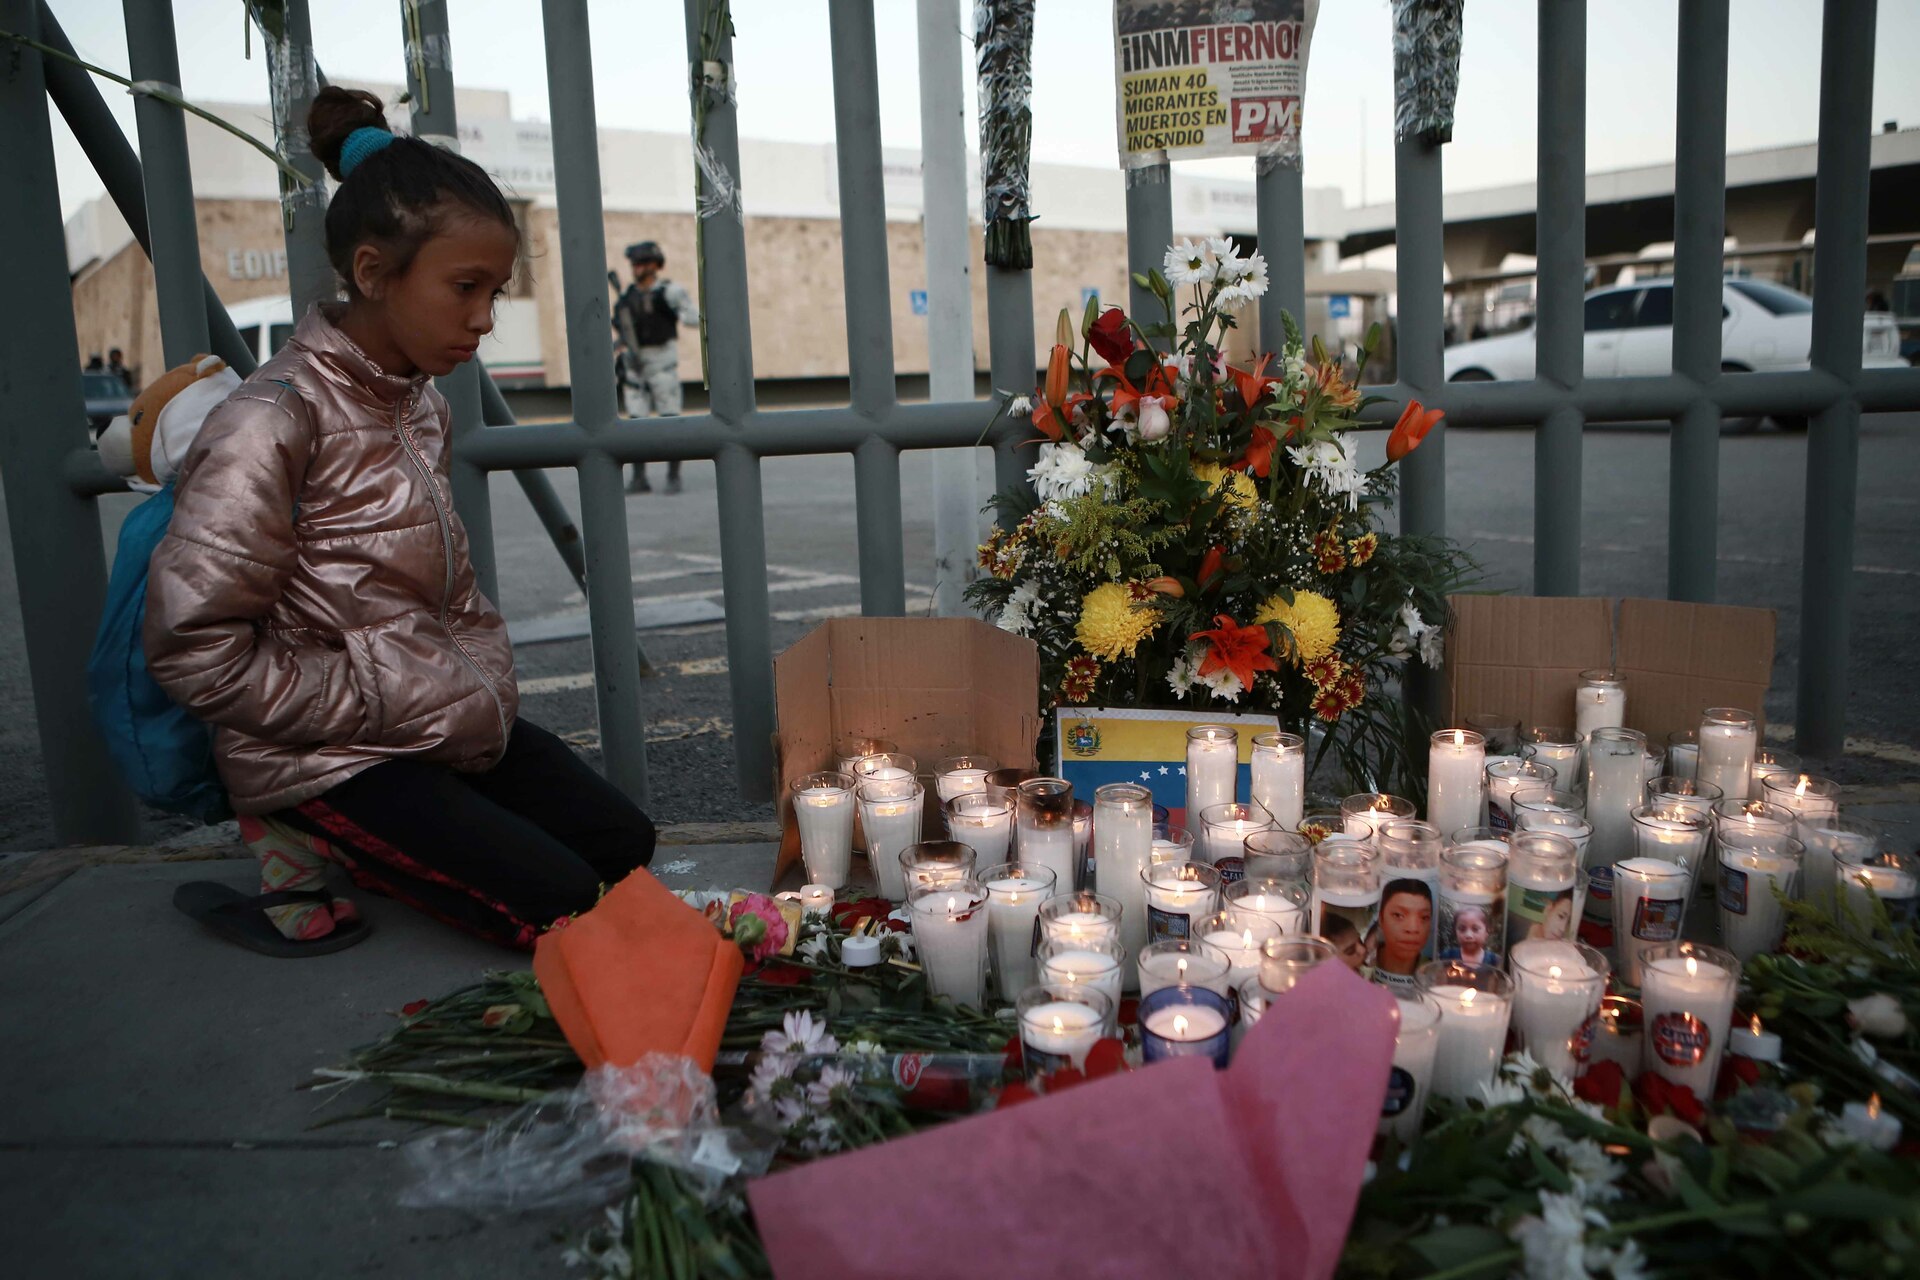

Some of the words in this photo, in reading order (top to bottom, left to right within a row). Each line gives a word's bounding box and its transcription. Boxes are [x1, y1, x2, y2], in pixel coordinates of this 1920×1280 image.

[1121, 23, 1302, 73] ¡INMFIERNO!
[1124, 75, 1180, 97] SUMAN
[1185, 73, 1207, 89] 40
[1125, 91, 1218, 115] MIGRANTES
[1126, 111, 1201, 135] MUERTOS
[1206, 109, 1227, 126] EN
[1235, 100, 1300, 137] PM
[1128, 129, 1204, 151] INCENDIO
